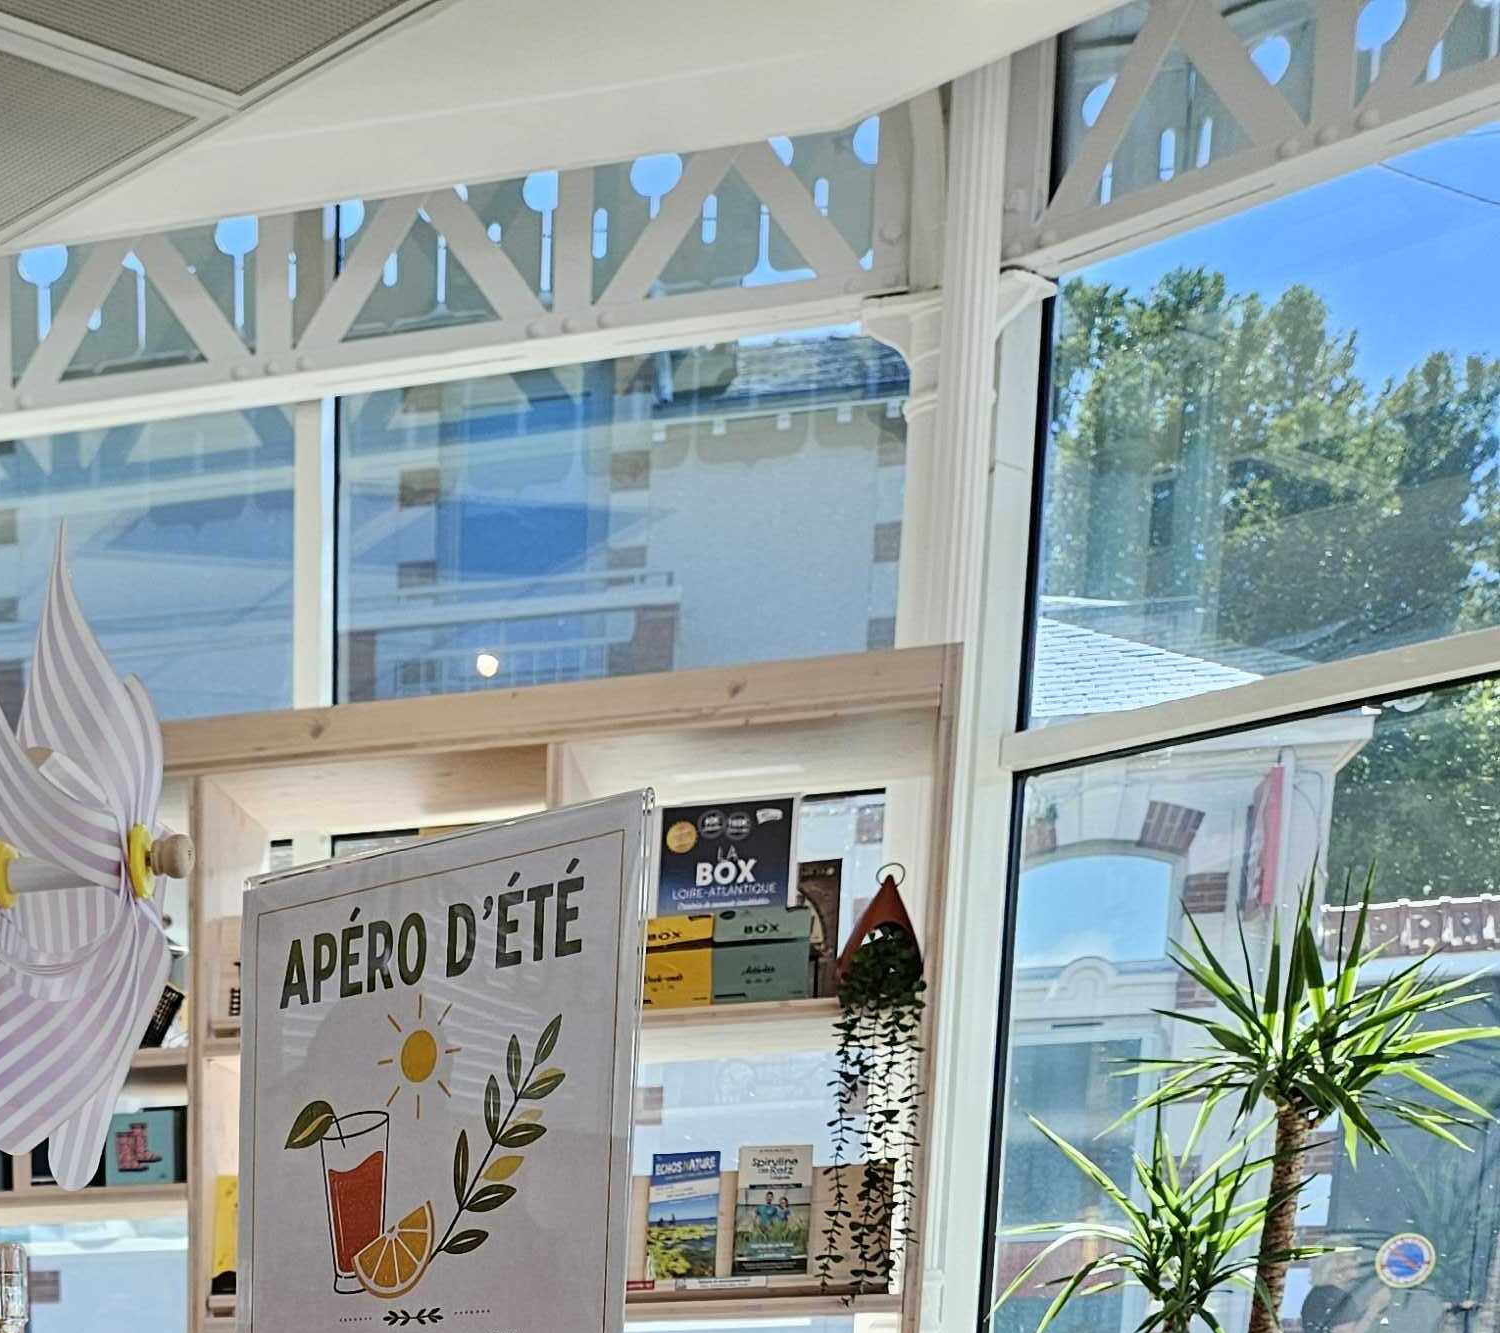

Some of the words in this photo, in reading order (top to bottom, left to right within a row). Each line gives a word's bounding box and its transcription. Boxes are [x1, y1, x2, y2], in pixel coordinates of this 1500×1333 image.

[695, 858, 757, 886] BOX
[672, 882, 777, 900] LOIRE-ATLANTIQUE
[279, 907, 427, 1010] APÉRO
[446, 857, 585, 978] D'ÉTÉ
[743, 923, 780, 934] BOX
